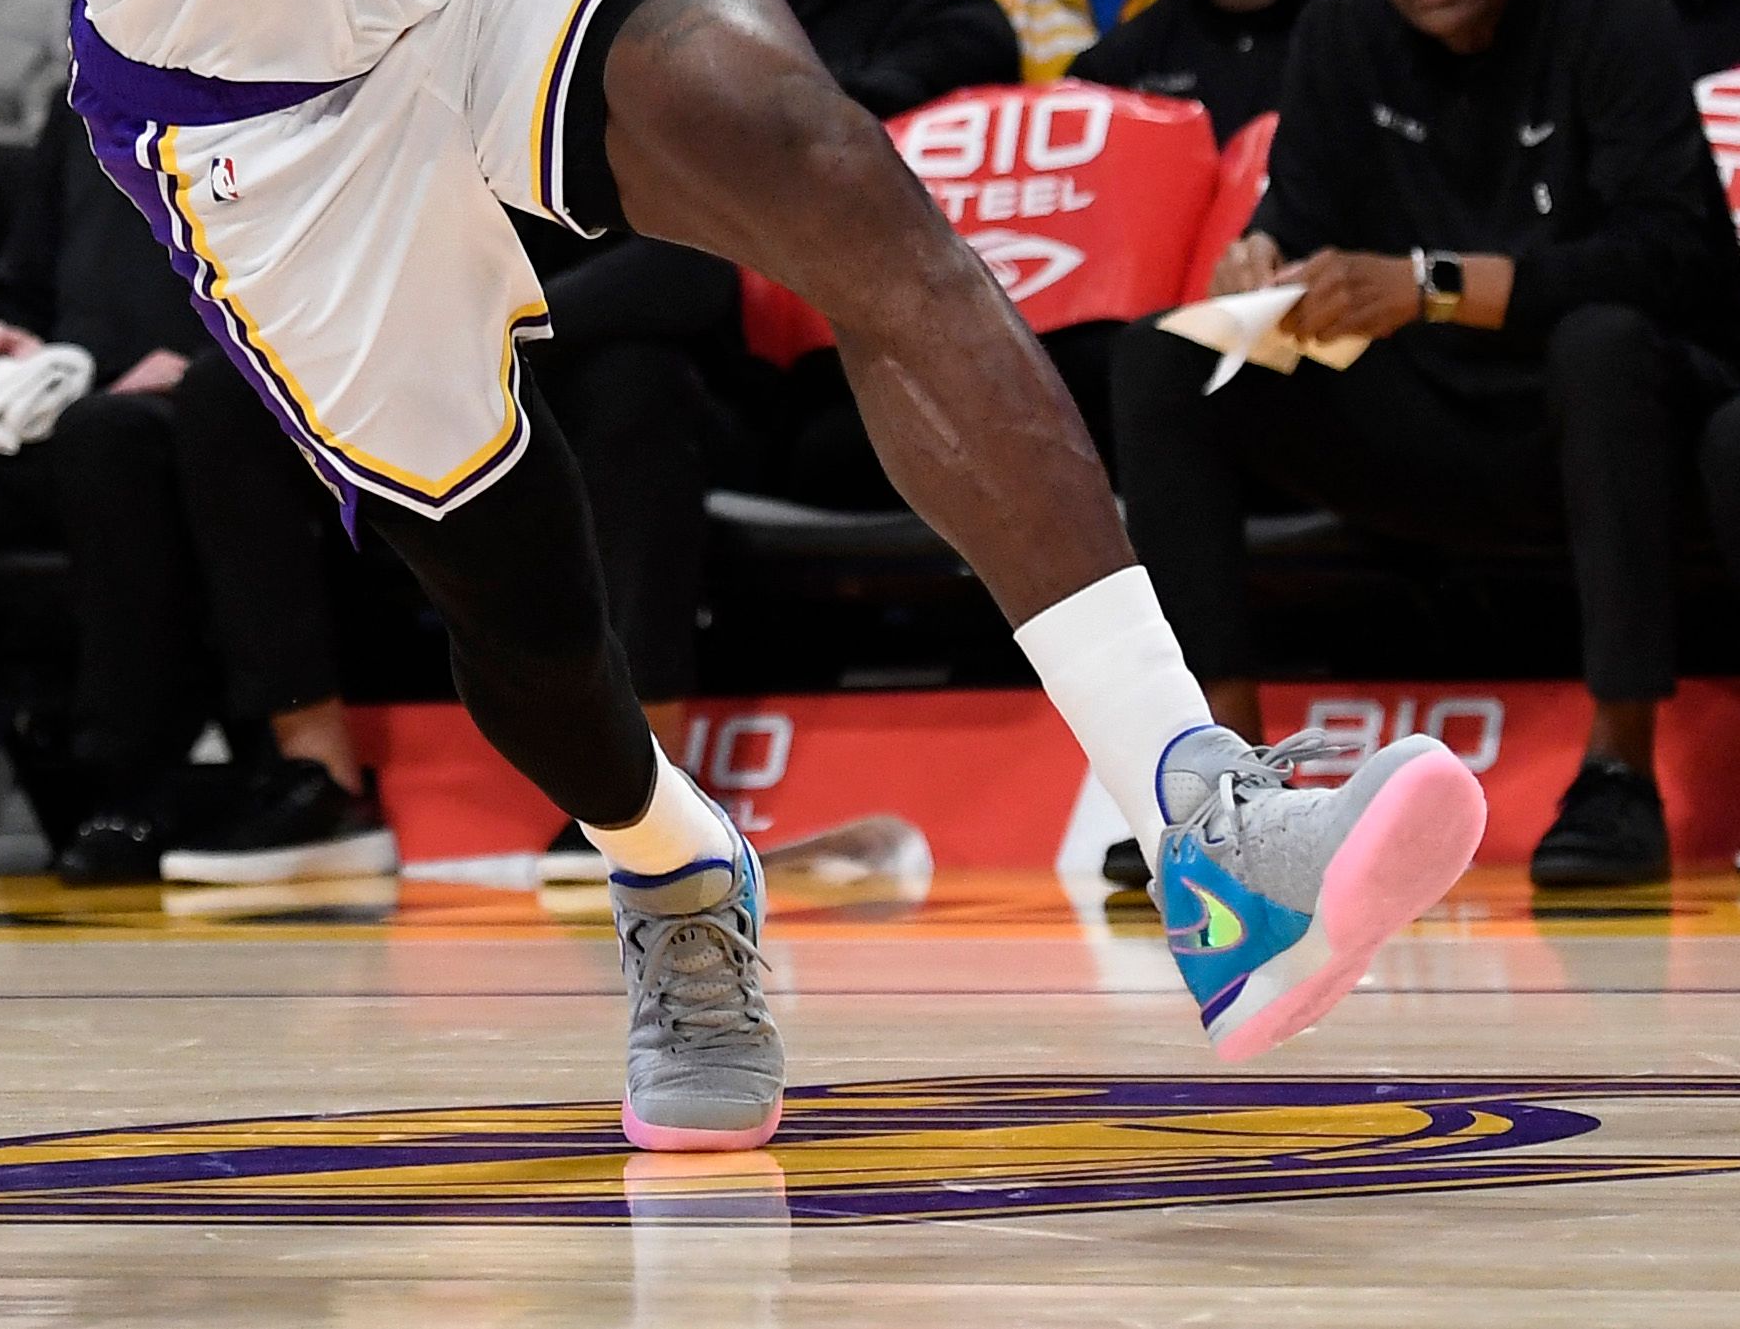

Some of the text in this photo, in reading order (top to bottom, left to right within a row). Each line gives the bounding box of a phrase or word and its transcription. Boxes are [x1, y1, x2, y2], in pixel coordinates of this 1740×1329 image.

[903, 92, 1114, 179] BIO
[924, 175, 1097, 224] TEEL
[682, 713, 794, 791] IO
